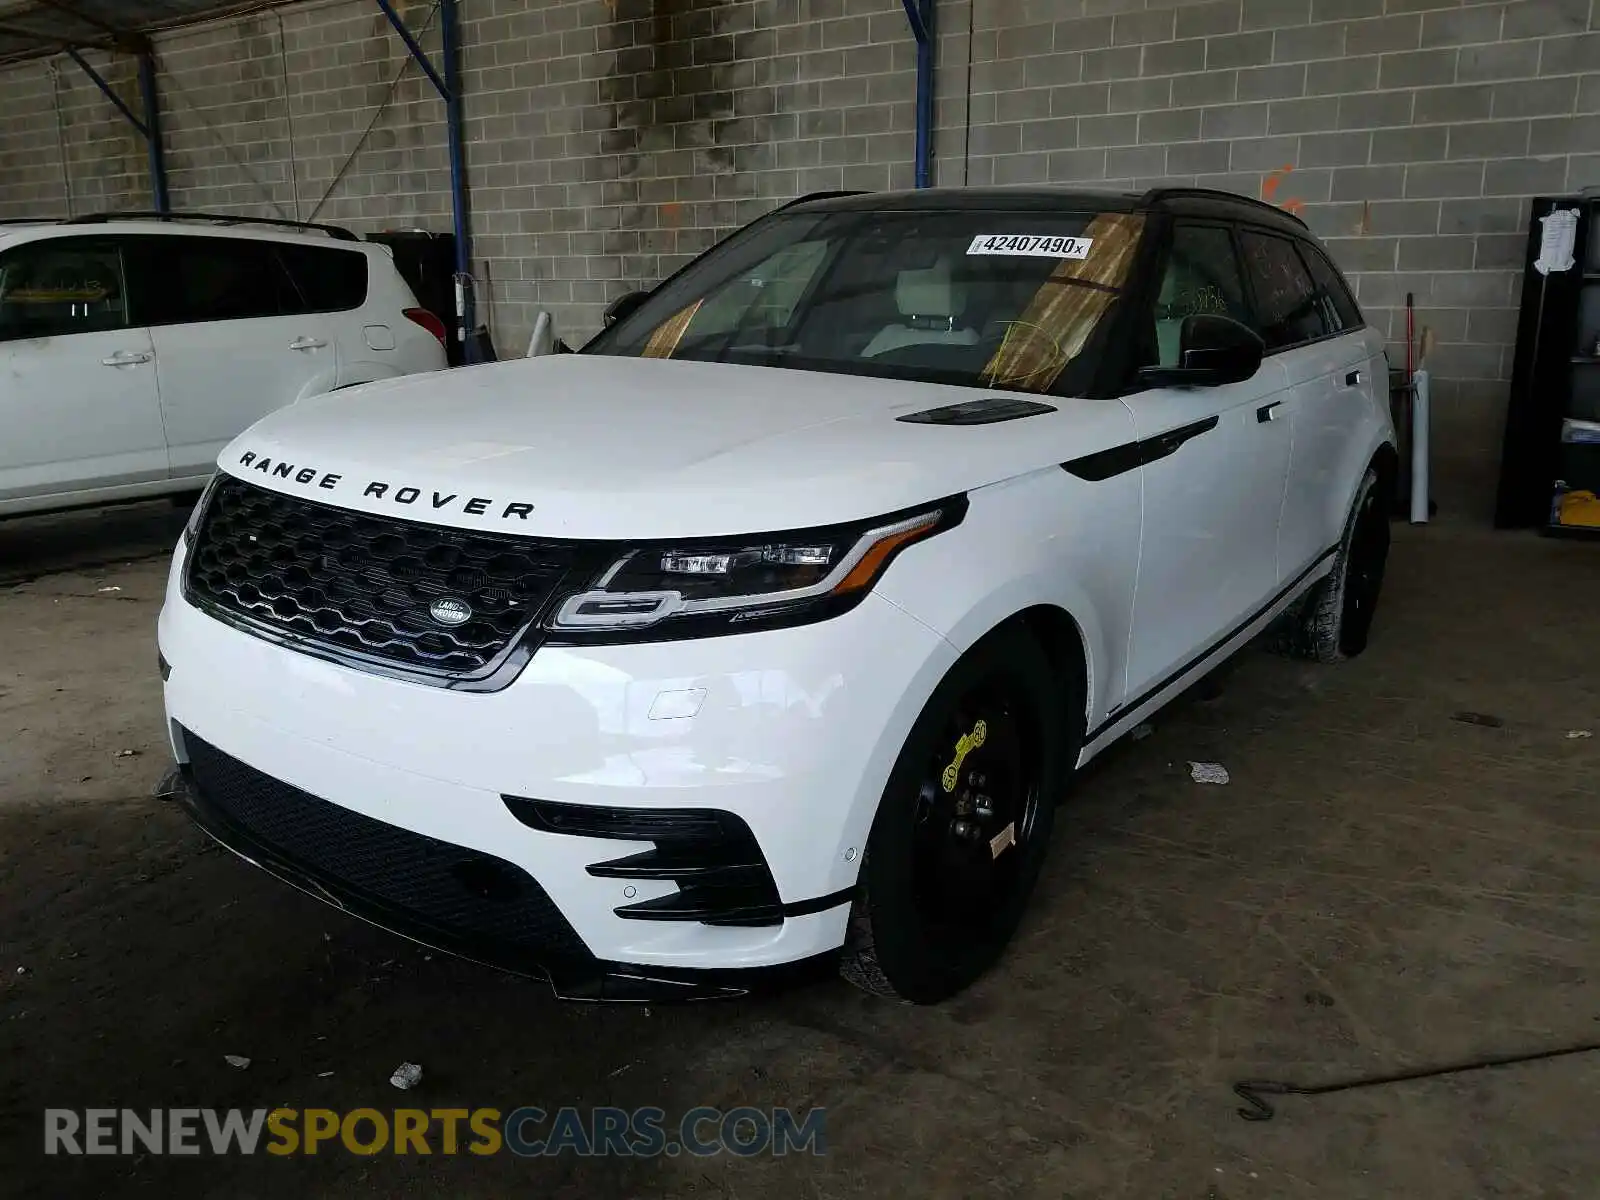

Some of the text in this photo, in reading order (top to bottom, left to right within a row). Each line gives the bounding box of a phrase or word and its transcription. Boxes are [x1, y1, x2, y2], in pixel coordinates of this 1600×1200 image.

[240, 451, 535, 519] RANGE ROVER
[439, 601, 459, 611] LAND
[437, 609, 463, 620] ROVER
